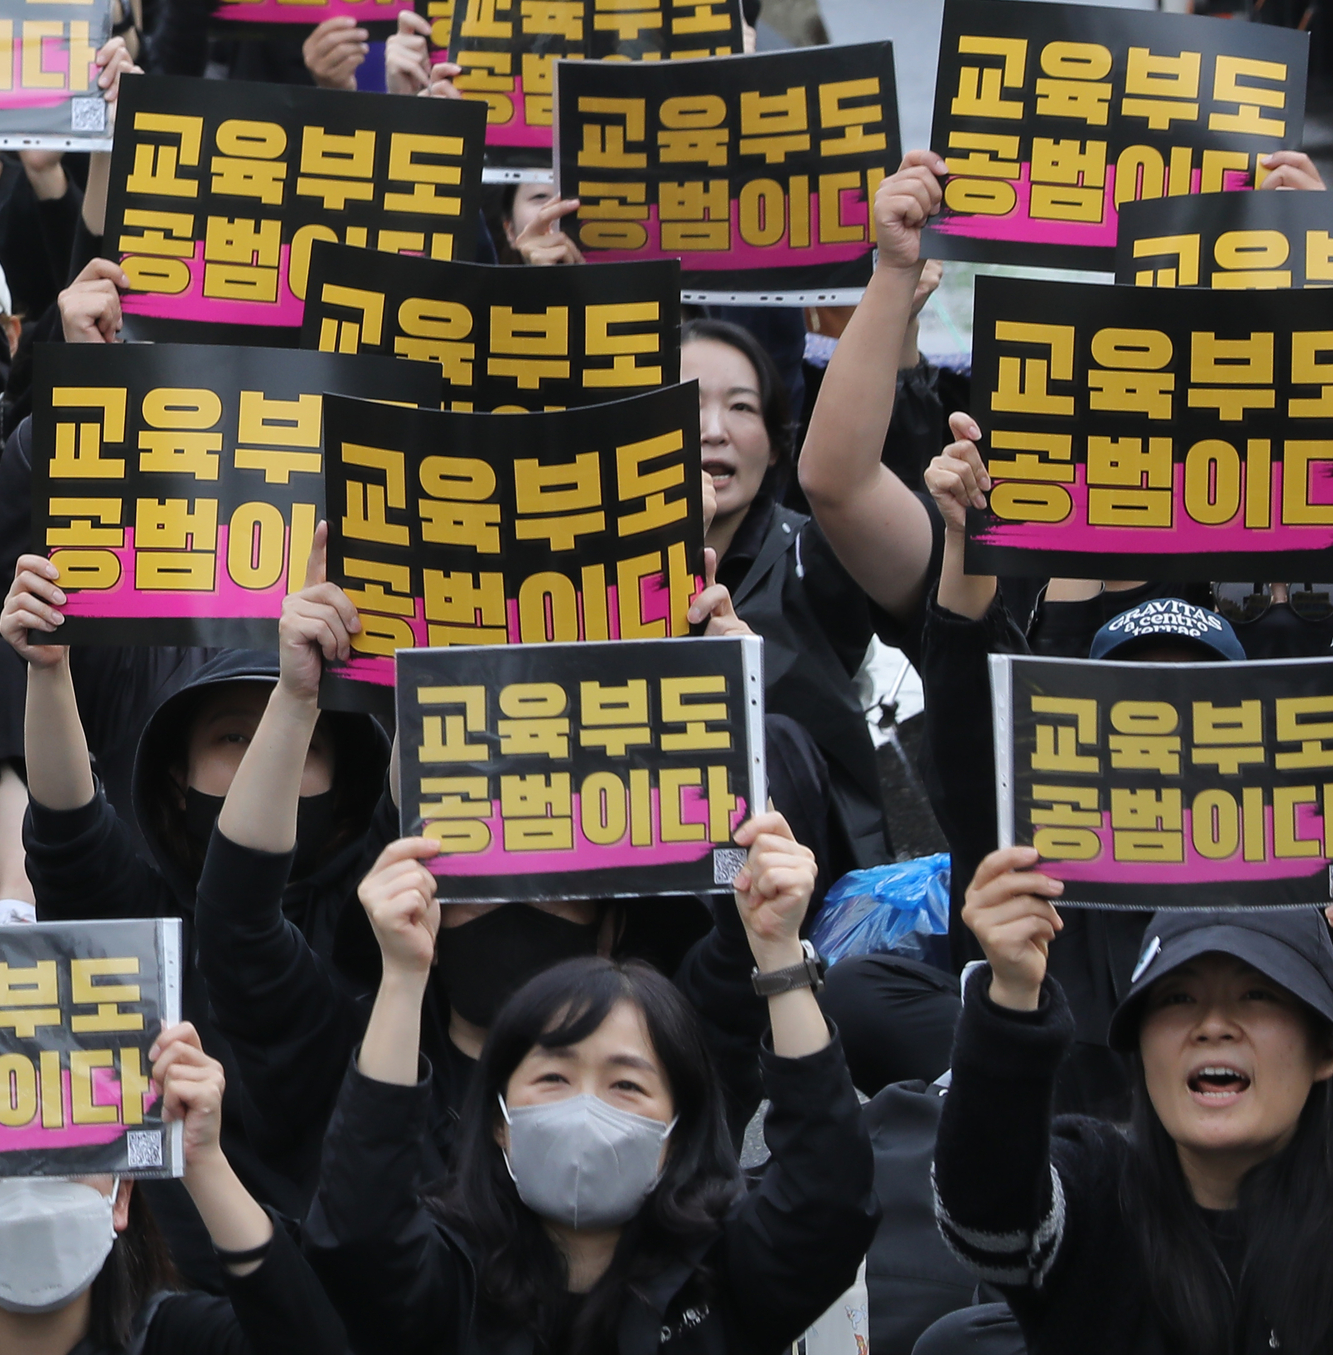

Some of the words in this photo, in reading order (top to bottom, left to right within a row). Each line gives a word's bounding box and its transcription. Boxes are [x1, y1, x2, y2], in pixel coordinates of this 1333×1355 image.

[577, 77, 888, 169] 교육부도
[950, 35, 1288, 138] 교육부도
[125, 112, 465, 216] 교육부도
[577, 166, 885, 251] 공범이다
[341, 428, 690, 556] 교육부도
[341, 541, 698, 658] 공범이다
[1109, 600, 1223, 632] GRAVITAS
[1140, 612, 1209, 633] centro
[416, 674, 732, 764] 교육부도
[418, 765, 738, 856] 공범이다
